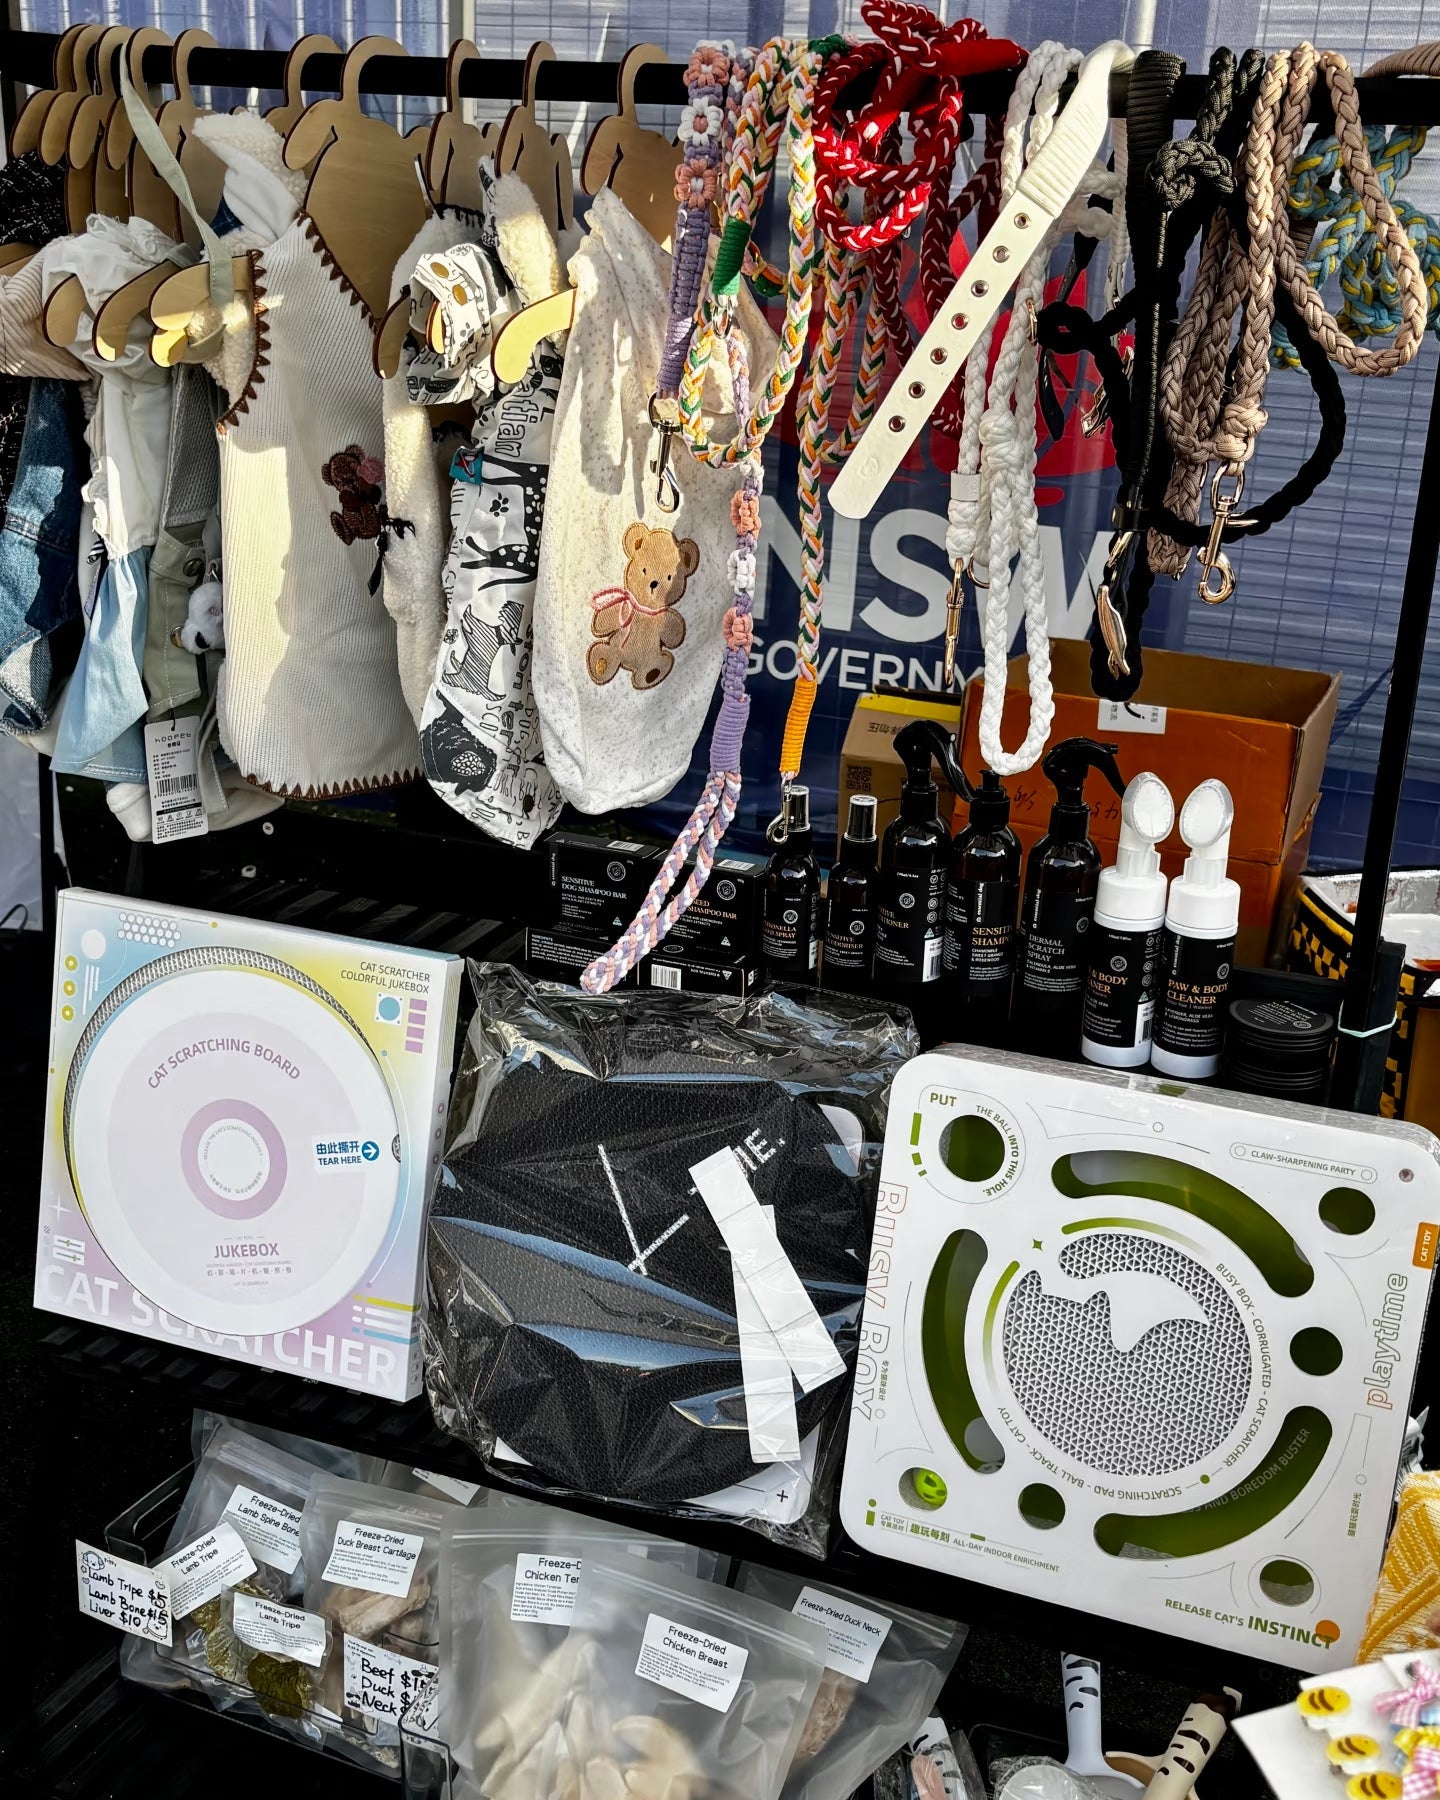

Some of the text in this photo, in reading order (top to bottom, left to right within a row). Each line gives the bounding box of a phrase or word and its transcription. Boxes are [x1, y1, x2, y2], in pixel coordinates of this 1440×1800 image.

[561, 876, 595, 887] SENSITIVE
[578, 886, 612, 897] SHAMPOO
[687, 906, 737, 920] SHAMPOO BAR
[774, 931, 796, 939] SPRAY
[1029, 934, 1064, 947] DERMAL
[1027, 950, 1052, 962] SPRAY
[1028, 942, 1065, 955] SCRATCH
[340, 970, 430, 994] COLORFUL JUKEBOX
[360, 962, 430, 982] CAT SCRATCHER
[1098, 972, 1128, 986] BODY
[1166, 990, 1217, 1004] CLEANER
[1168, 979, 1229, 994] PAW & BODY
[148, 1038, 300, 1089] CAT SCRATCHING BOARD
[930, 1092, 957, 1107] PUT
[316, 1140, 360, 1155] 由此撕开
[976, 1105, 1019, 1196] THE BALL INTO THIS HOLE.
[318, 1156, 362, 1166] TEAR HERE
[1250, 1150, 1356, 1176] CLAW-SHARPENING PARTY
[214, 1243, 280, 1258] JUKEBOX
[1420, 1230, 1432, 1262] CAT TOY
[41, 1264, 119, 1317] CAT
[1363, 1273, 1408, 1410] playtime
[1216, 1263, 1272, 1467] BUSY BOX CORRUGATED CAT SCRATCHER
[998, 1407, 1182, 1500] SCRATCHING PAD BALL TRACK CAT TOY
[1204, 1428, 1311, 1512] AND BOREDOM BUSTER
[238, 1504, 259, 1518] Lamb
[260, 1514, 280, 1528] Spine
[250, 1495, 302, 1524] Freeze-Dried
[880, 1514, 892, 1522] CAT
[354, 1528, 405, 1546] Freeze-Dried
[910, 1523, 951, 1542] 趣玩每刻
[170, 1536, 216, 1568] Freeze-Dried
[338, 1536, 416, 1560] Duck Breast Cartilage
[953, 1538, 1060, 1572] ALL-DAY INDOOR ENRICHMENT
[180, 1548, 219, 1575] Lamb Tripe
[88, 1567, 168, 1609] Lamb Tripe $5
[524, 1570, 562, 1582] Chicken
[88, 1584, 116, 1605] Lamb
[118, 1595, 146, 1618] Bone
[90, 1599, 141, 1627] Liver $10
[255, 1602, 306, 1621] Freeze-Dried
[259, 1612, 301, 1630] Lamb Tripe
[800, 1598, 882, 1636] Freeze-Dried Duck Neck
[1165, 1598, 1335, 1650] RELEASE CAT'S INSTINCT
[668, 1625, 727, 1655] Freeze-Dried
[662, 1636, 697, 1658] Chicken
[698, 1651, 728, 1669] Breast
[362, 1657, 396, 1684] Beef
[362, 1676, 396, 1698] Duck
[362, 1691, 398, 1716] Neck
